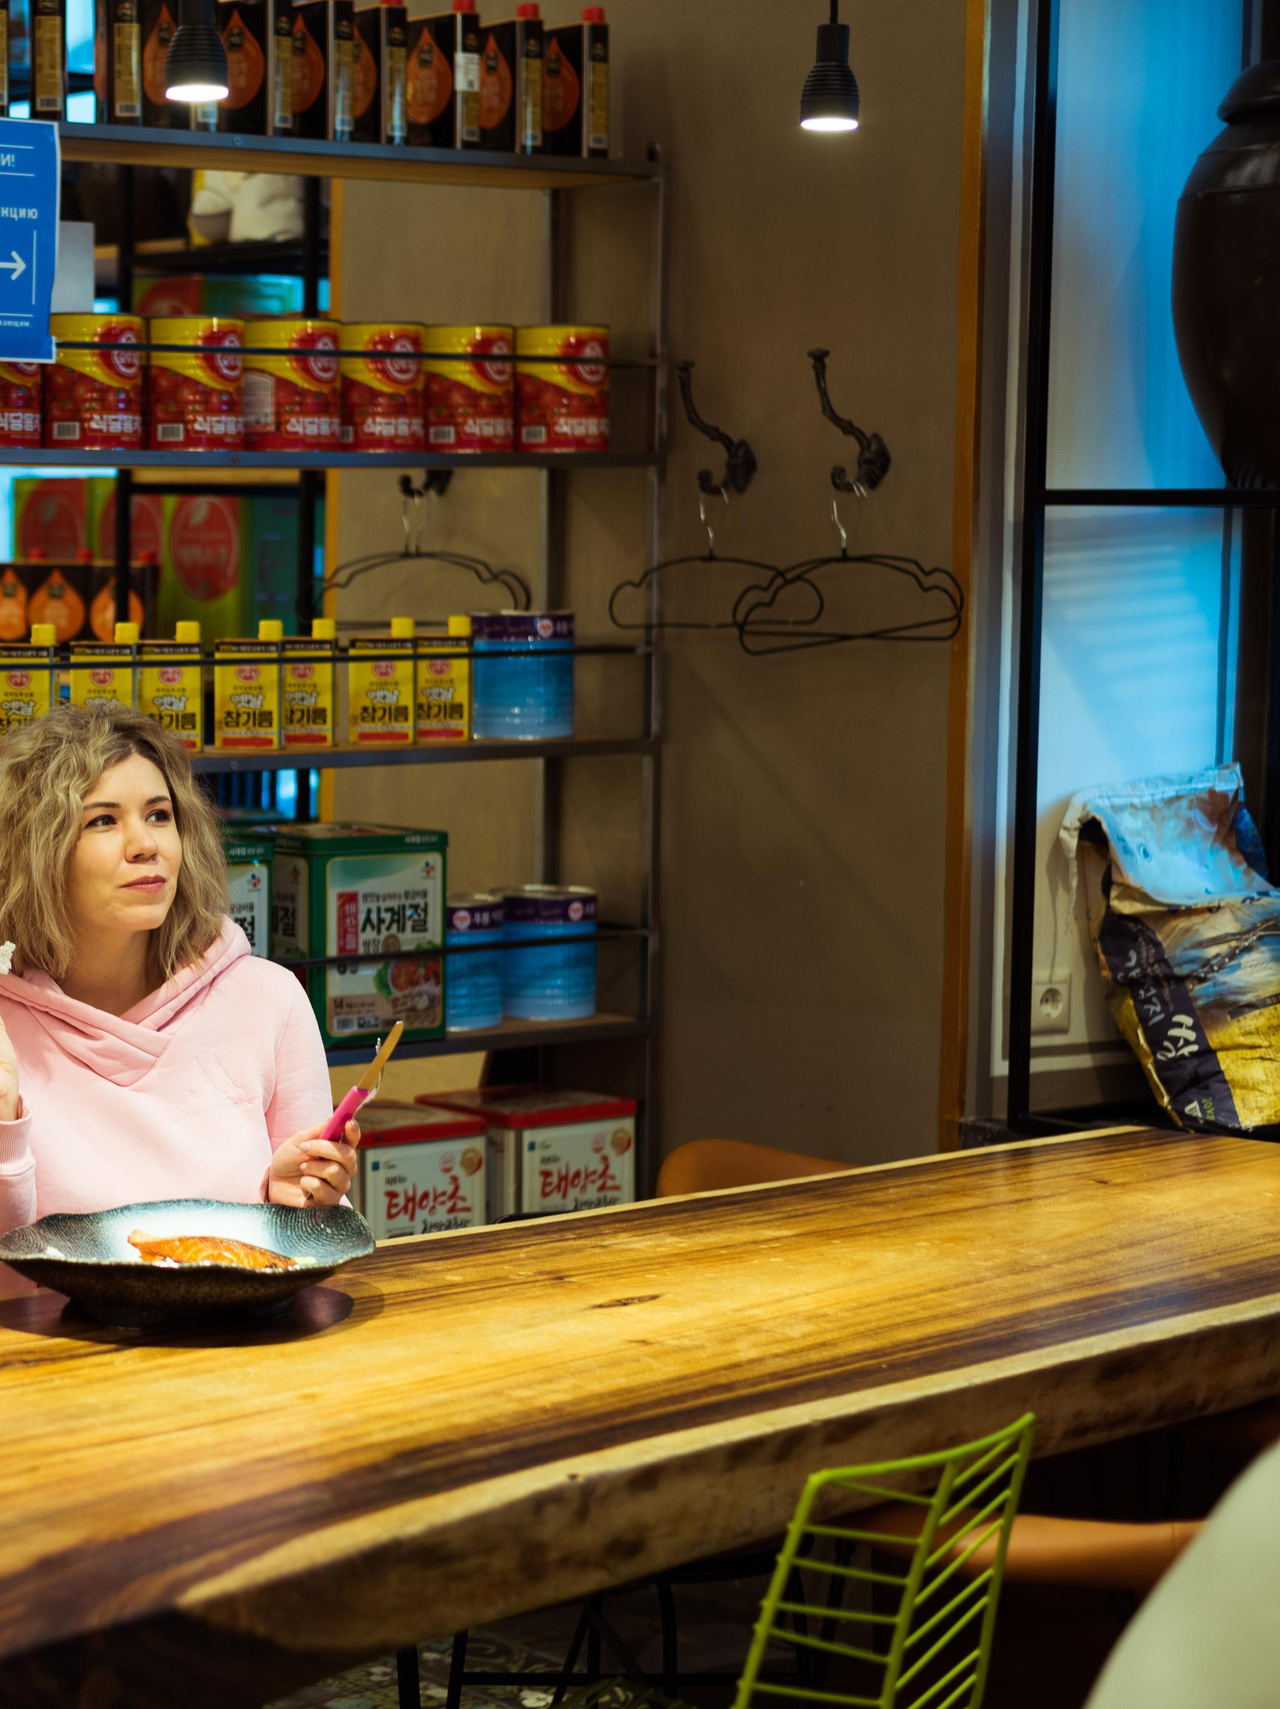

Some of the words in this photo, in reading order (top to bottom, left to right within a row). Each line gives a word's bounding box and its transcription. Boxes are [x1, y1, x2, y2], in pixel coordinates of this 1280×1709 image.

[0, 700, 35, 717] 옛날
[223, 710, 273, 728] 참기름
[359, 705, 409, 723] 참기름
[360, 902, 429, 936] 사계절
[539, 1154, 622, 1200] 태양초
[384, 1174, 472, 1222] 태양초
